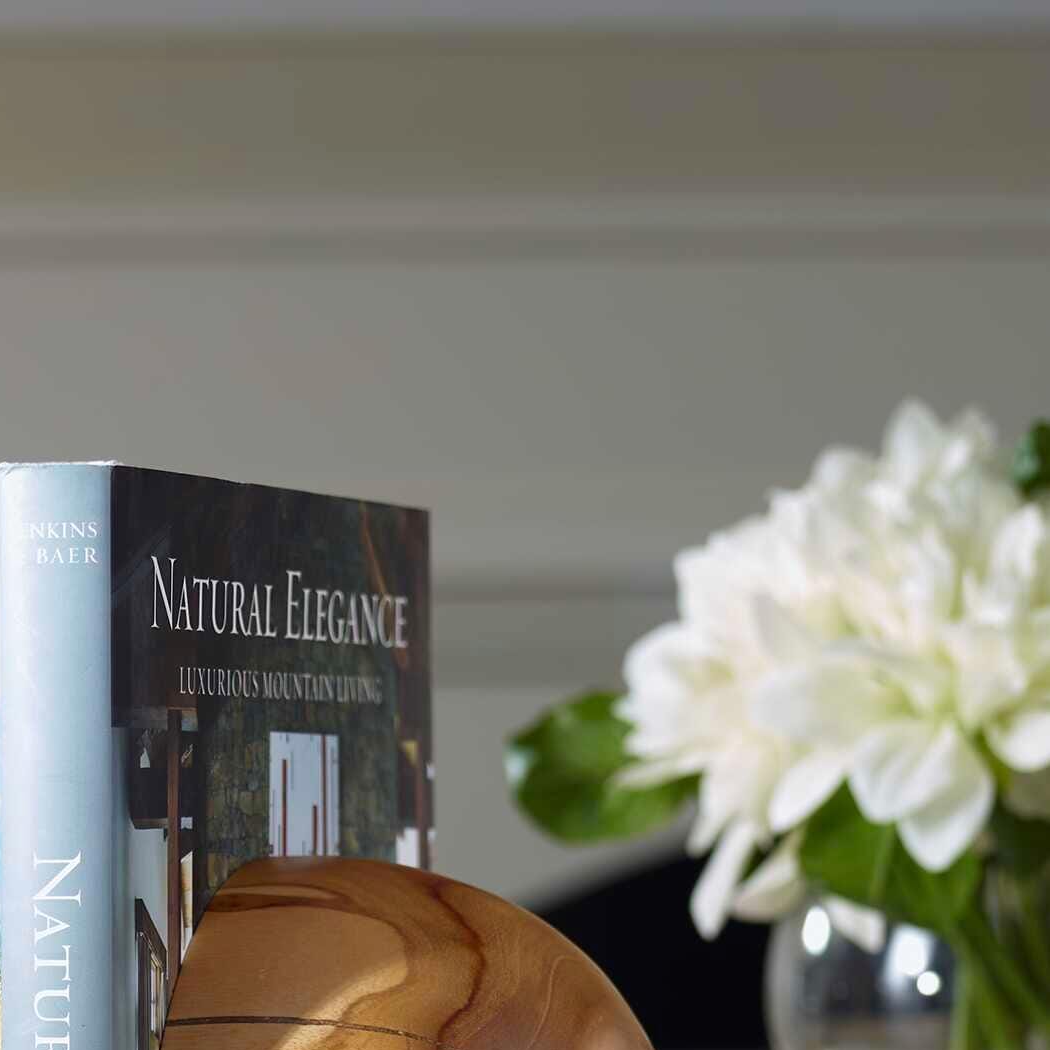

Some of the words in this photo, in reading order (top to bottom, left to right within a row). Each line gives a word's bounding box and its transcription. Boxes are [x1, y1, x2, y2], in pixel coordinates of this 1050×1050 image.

[27, 519, 99, 540] NKINS
[35, 545, 99, 565] BAER
[150, 555, 277, 638] NATURAL
[285, 569, 409, 649] ELEGANCE
[179, 666, 259, 698] LUXURIOUS
[262, 671, 336, 702] MOUNTAIN
